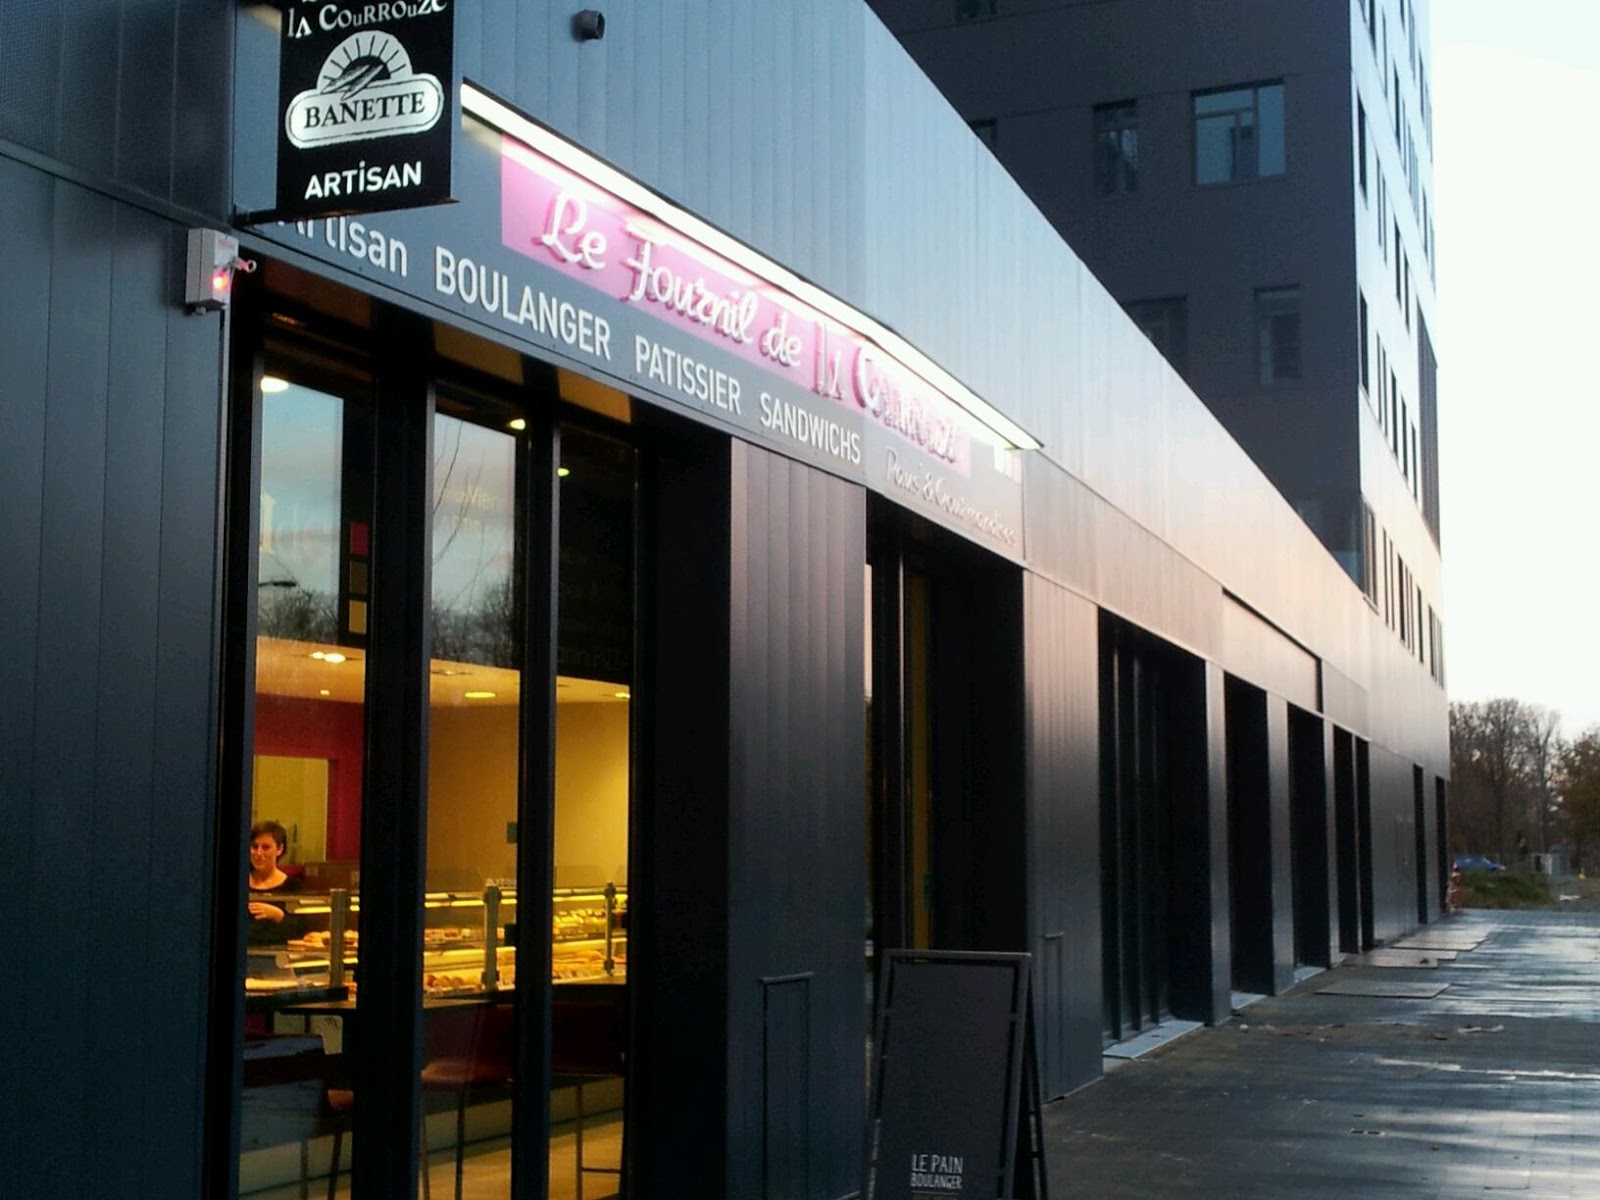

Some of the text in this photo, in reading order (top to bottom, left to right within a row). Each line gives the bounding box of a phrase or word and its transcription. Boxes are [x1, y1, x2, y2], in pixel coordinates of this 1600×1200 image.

[304, 91, 426, 128] BANETTE
[540, 190, 608, 270] Le
[622, 220, 758, 345] Fournil
[763, 310, 801, 367] de
[277, 215, 862, 465] tisan BOULANGER PATISSIER SANDWICHS
[910, 1172, 963, 1190] BOULANGER
[911, 1153, 963, 1174] LE PAIN
